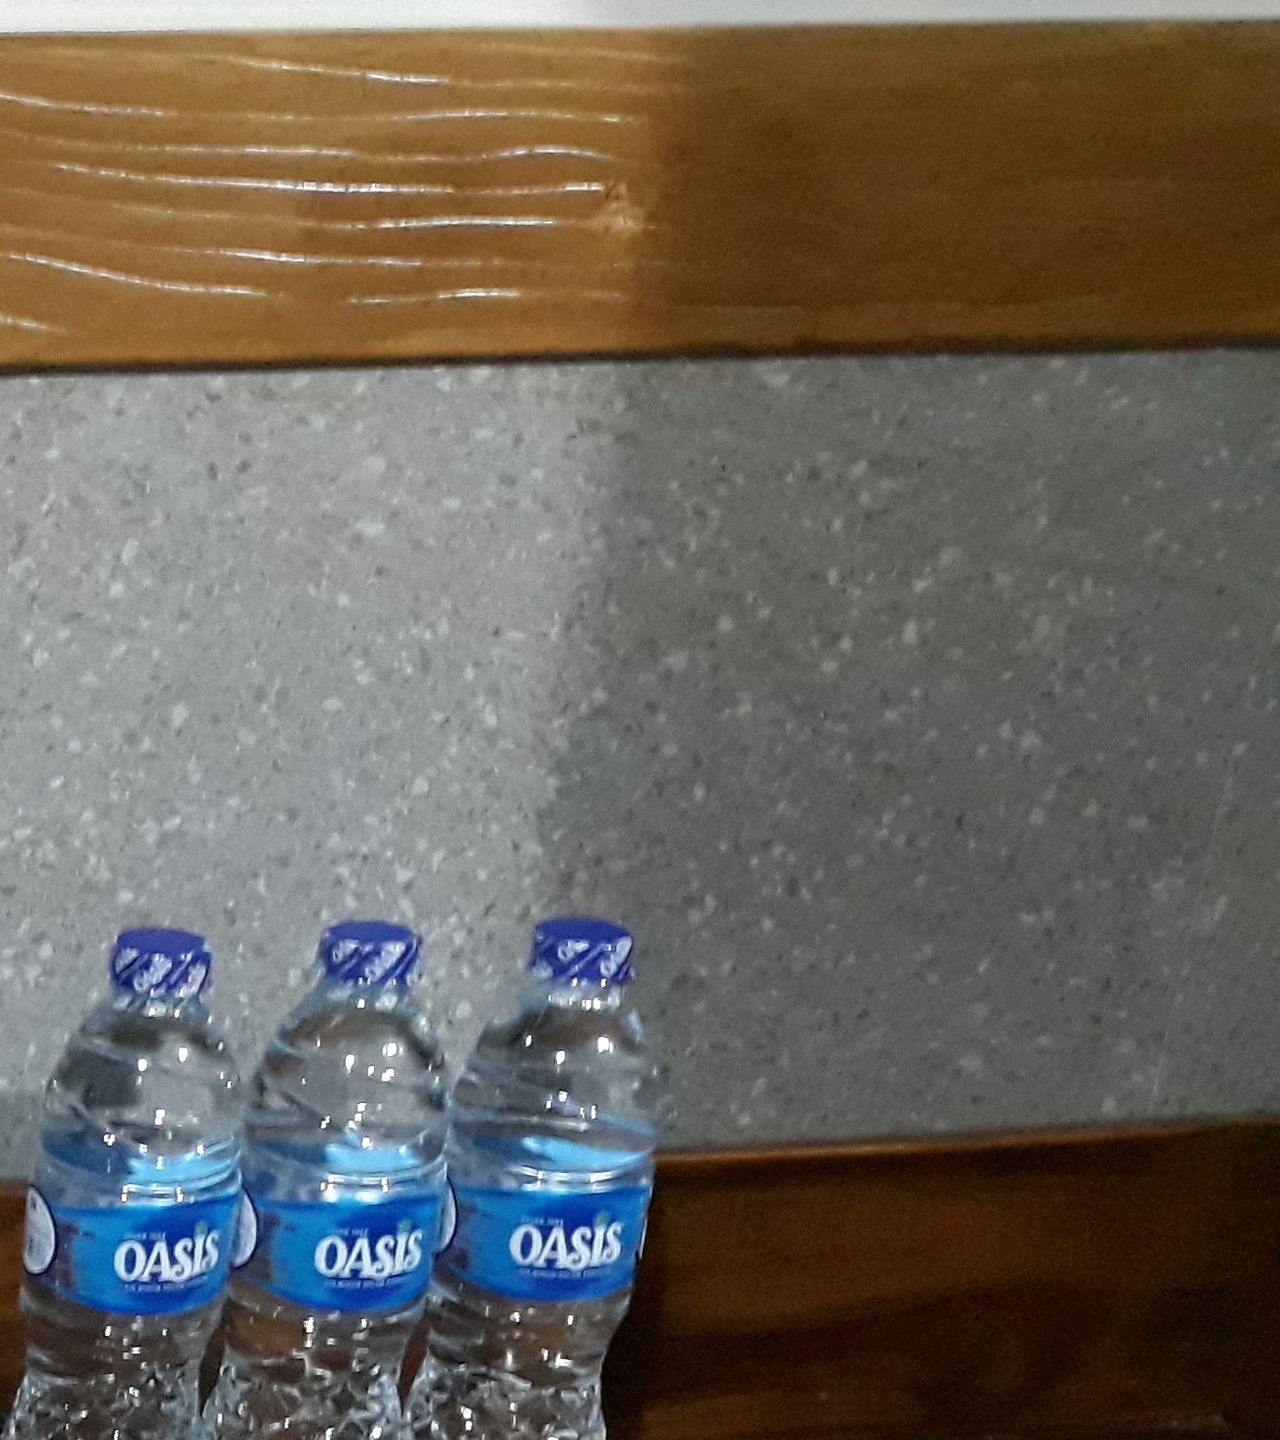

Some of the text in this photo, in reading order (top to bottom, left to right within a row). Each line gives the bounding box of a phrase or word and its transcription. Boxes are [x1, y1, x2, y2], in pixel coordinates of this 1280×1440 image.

[113, 1226, 220, 1283] OASIS
[314, 1224, 422, 1280] OASIS
[509, 1216, 623, 1271] OASIS
